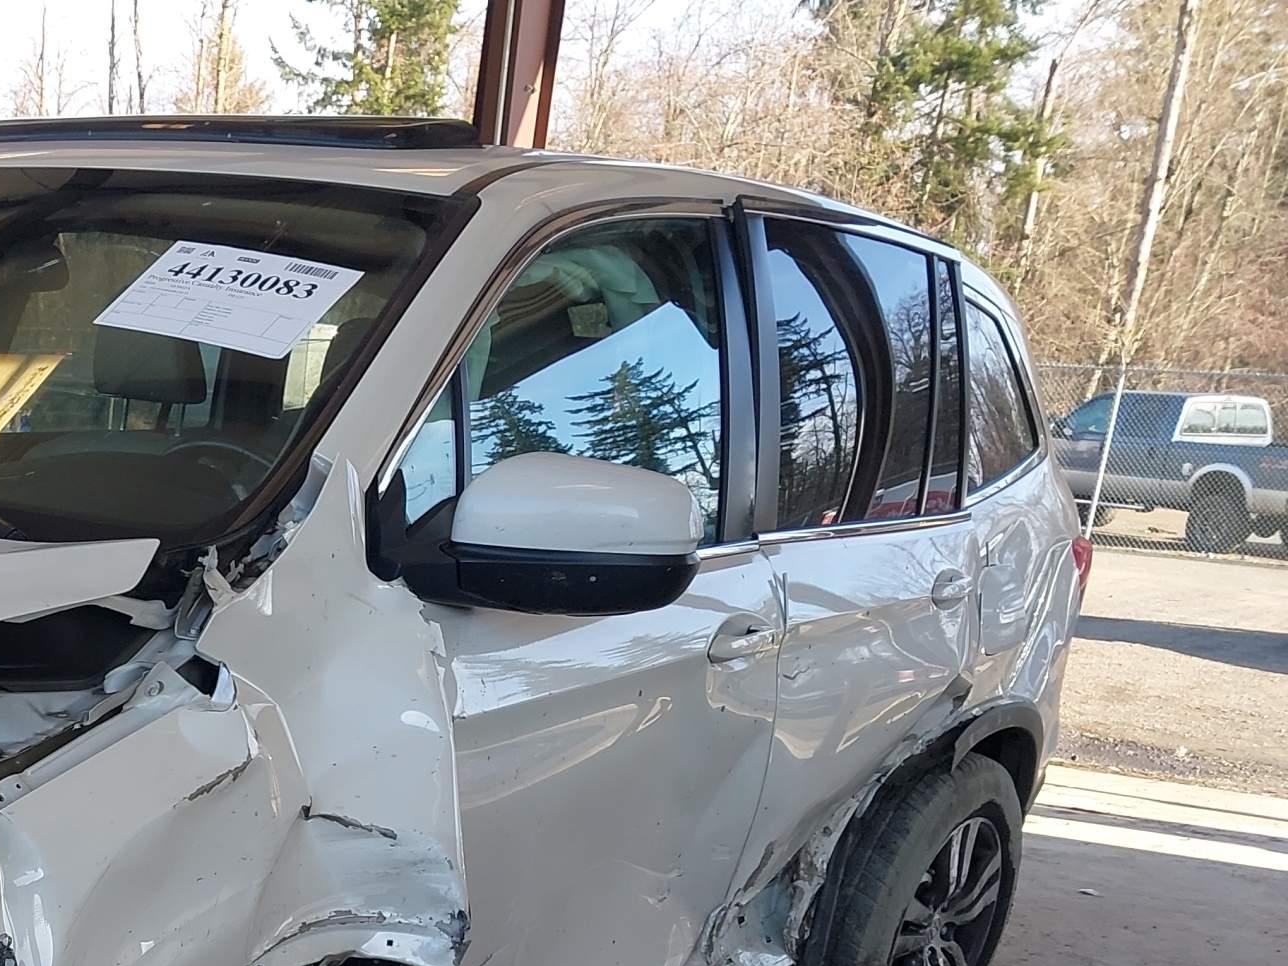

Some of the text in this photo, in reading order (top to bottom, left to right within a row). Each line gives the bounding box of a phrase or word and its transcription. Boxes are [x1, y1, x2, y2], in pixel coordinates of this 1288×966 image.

[148, 274, 191, 287] Progressive
[225, 286, 263, 298] Insurance
[168, 262, 318, 299] 44130083
